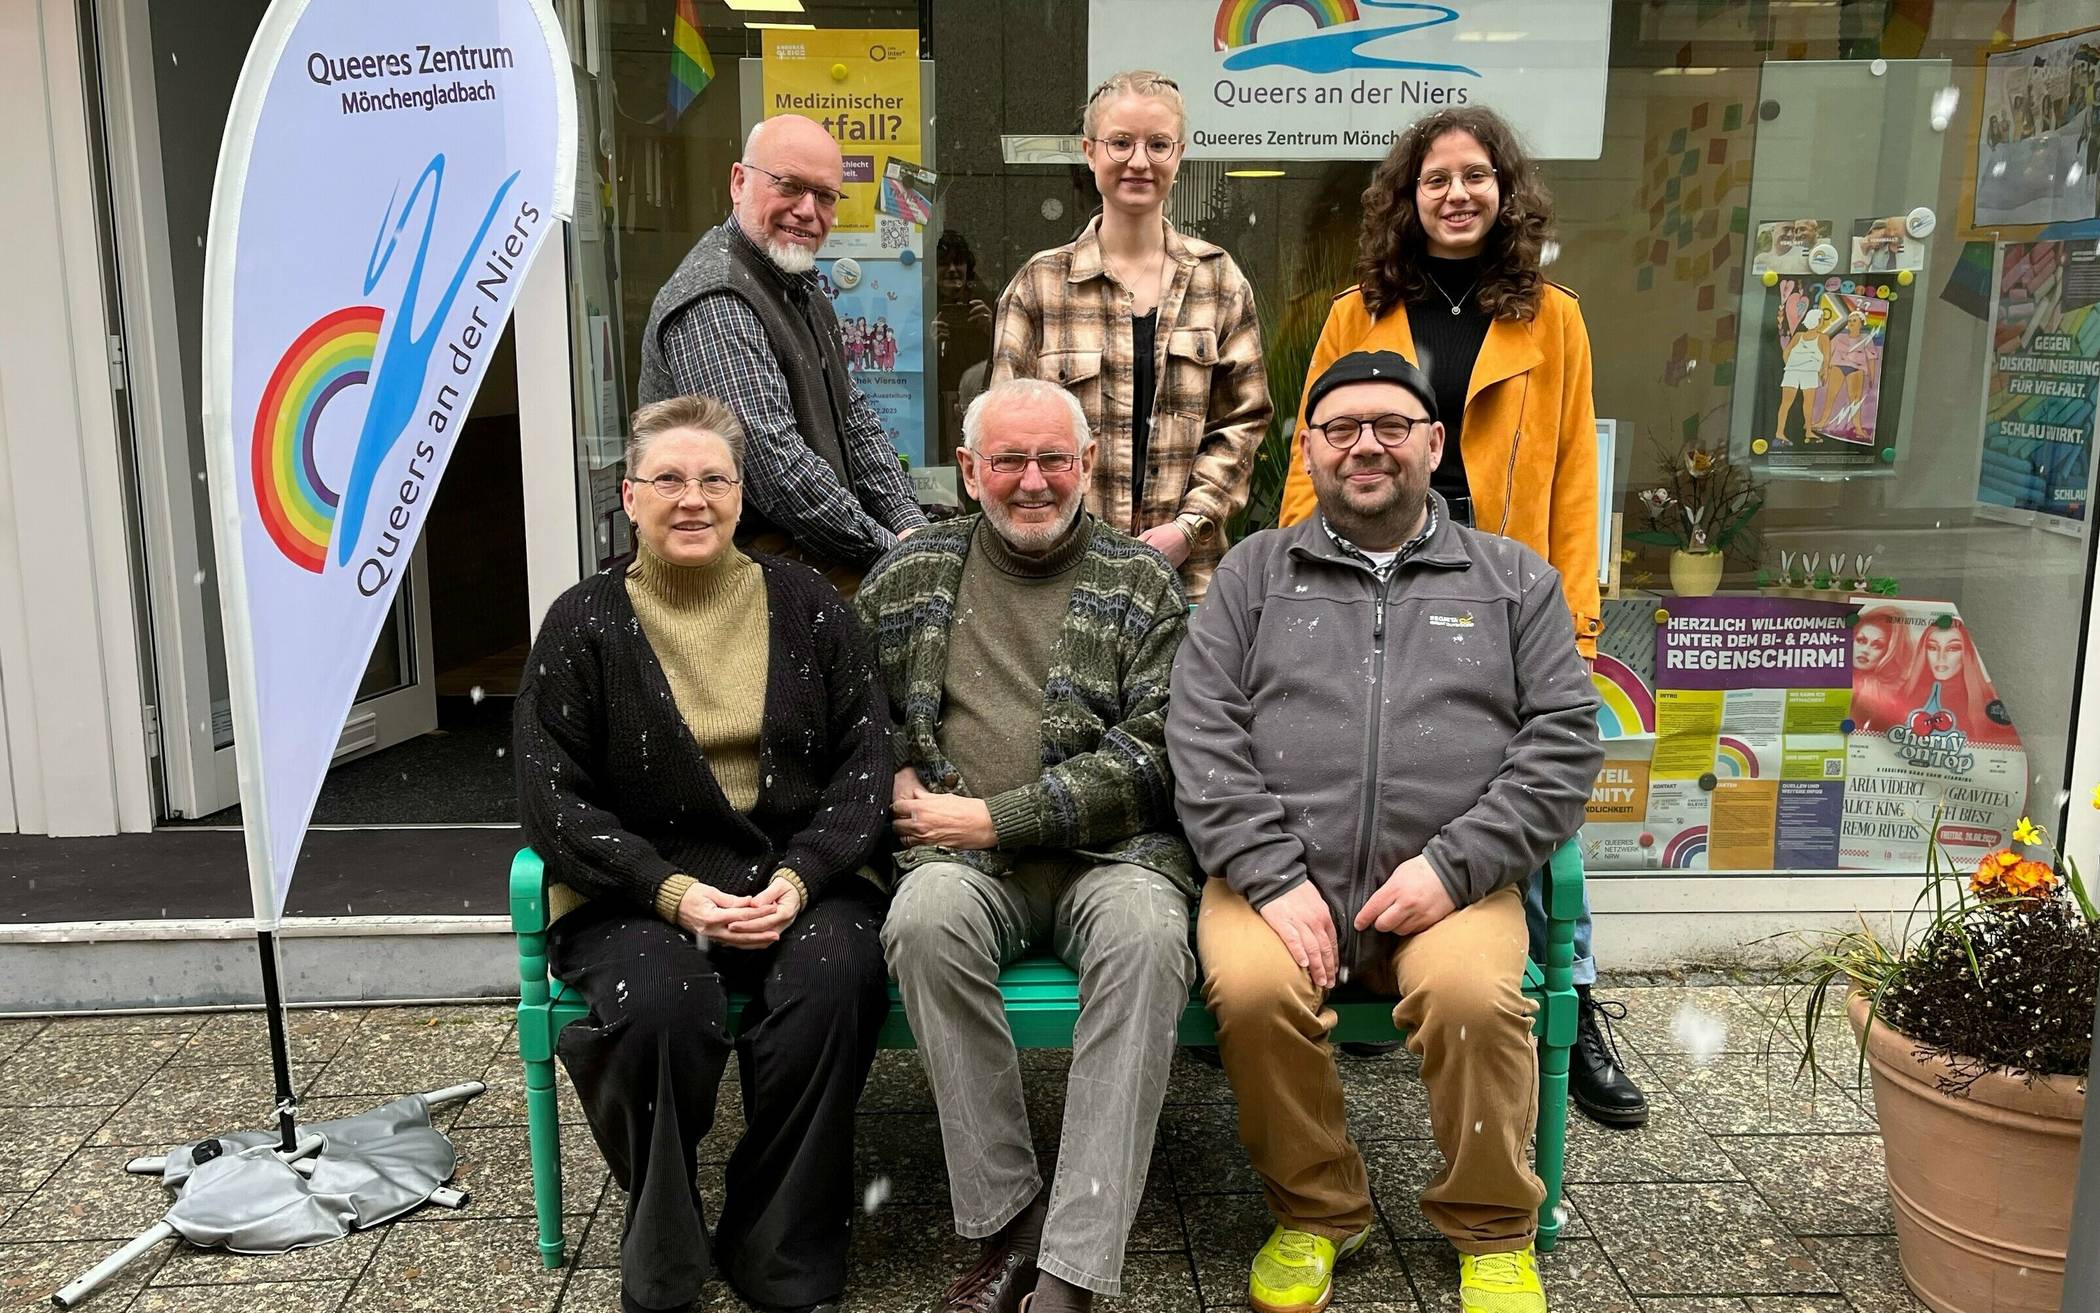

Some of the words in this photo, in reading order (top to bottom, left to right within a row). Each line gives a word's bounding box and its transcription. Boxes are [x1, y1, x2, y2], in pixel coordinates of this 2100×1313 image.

[308, 47, 412, 84] Queeres
[416, 46, 514, 75] Zentrum
[341, 80, 496, 115] Mönchengladbach
[776, 94, 904, 109] Medizinischer
[1213, 80, 1307, 108] Queers
[1314, 86, 1343, 104] an
[1350, 80, 1393, 104] der
[1401, 80, 1468, 104] Niers
[822, 113, 903, 141] tfall?
[1193, 130, 1262, 146] Queeres
[1267, 131, 1338, 146] Zentrum
[1343, 130, 1400, 146] Mönch
[2034, 335, 2071, 351] GEGEN
[2000, 356, 2099, 377] DISKRIMINIERUNG
[2010, 376, 2032, 394] FÜR
[2034, 380, 2085, 398] VIELFALT.
[356, 440, 434, 598] Queers
[428, 384, 459, 436] an
[448, 307, 485, 376] der
[477, 201, 540, 303] Niers
[2001, 420, 2045, 440] SCHLAU
[2046, 425, 2084, 444] WIRKT.
[2054, 488, 2086, 501] SCHLAU
[1667, 617, 1746, 631] HERZLICH
[1752, 617, 1846, 631] WILLKOMMEN
[1667, 633, 1723, 648] UNTER
[1727, 633, 1758, 648] DEM
[1761, 633, 1781, 646] BI-
[1785, 632, 1796, 646] &
[1800, 632, 1846, 646] PAN+-
[1667, 647, 1846, 670] REGENSCHIRM!
[1888, 726, 1965, 753] Cherry
[1901, 746, 1931, 762] on
[1931, 749, 1974, 774] Top
[1597, 768, 1633, 784] TEIL
[1591, 787, 1636, 803] NITY
[1849, 777, 1876, 793] ARIA
[1881, 777, 1925, 796] VIDERCI
[1949, 786, 2009, 807] GRAVITEA
[1842, 799, 1872, 815] ALICE
[1875, 801, 1905, 817] KING
[1959, 808, 1994, 824] BIEST
[1842, 821, 1875, 837] REMO
[1877, 823, 1919, 840] RIVERS
